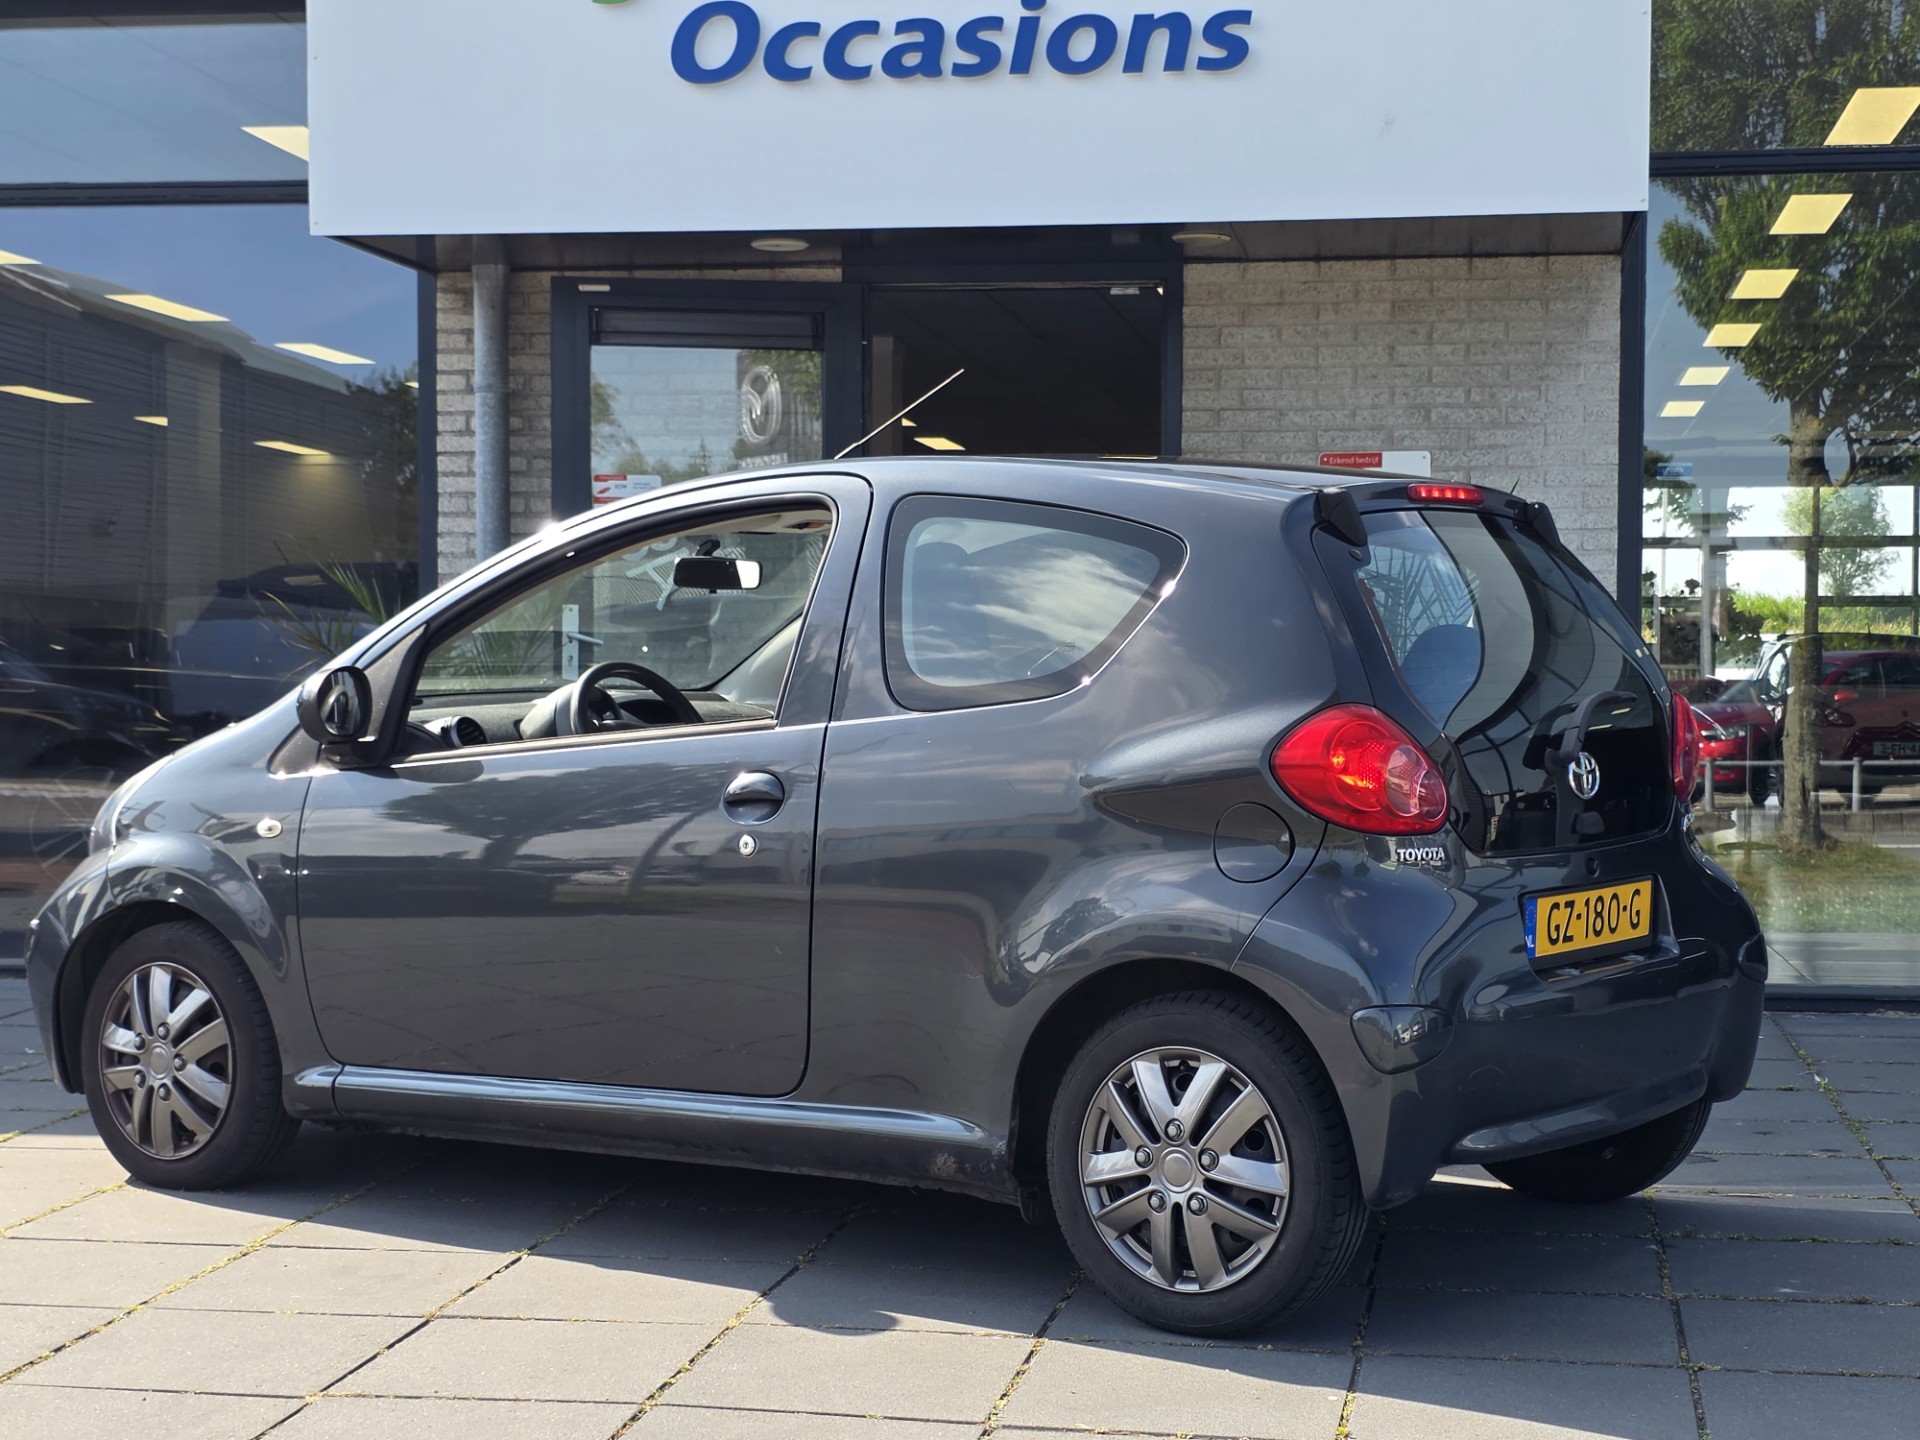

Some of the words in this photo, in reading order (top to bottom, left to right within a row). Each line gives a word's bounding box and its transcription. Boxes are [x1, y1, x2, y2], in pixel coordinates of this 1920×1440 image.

[670, 0, 1253, 85] Occasions
[1329, 456, 1355, 465] Erkend
[1355, 455, 1379, 465] bedrijf
[1397, 847, 1445, 862] TOYOTA
[1547, 888, 1641, 946] GZ-180-G
